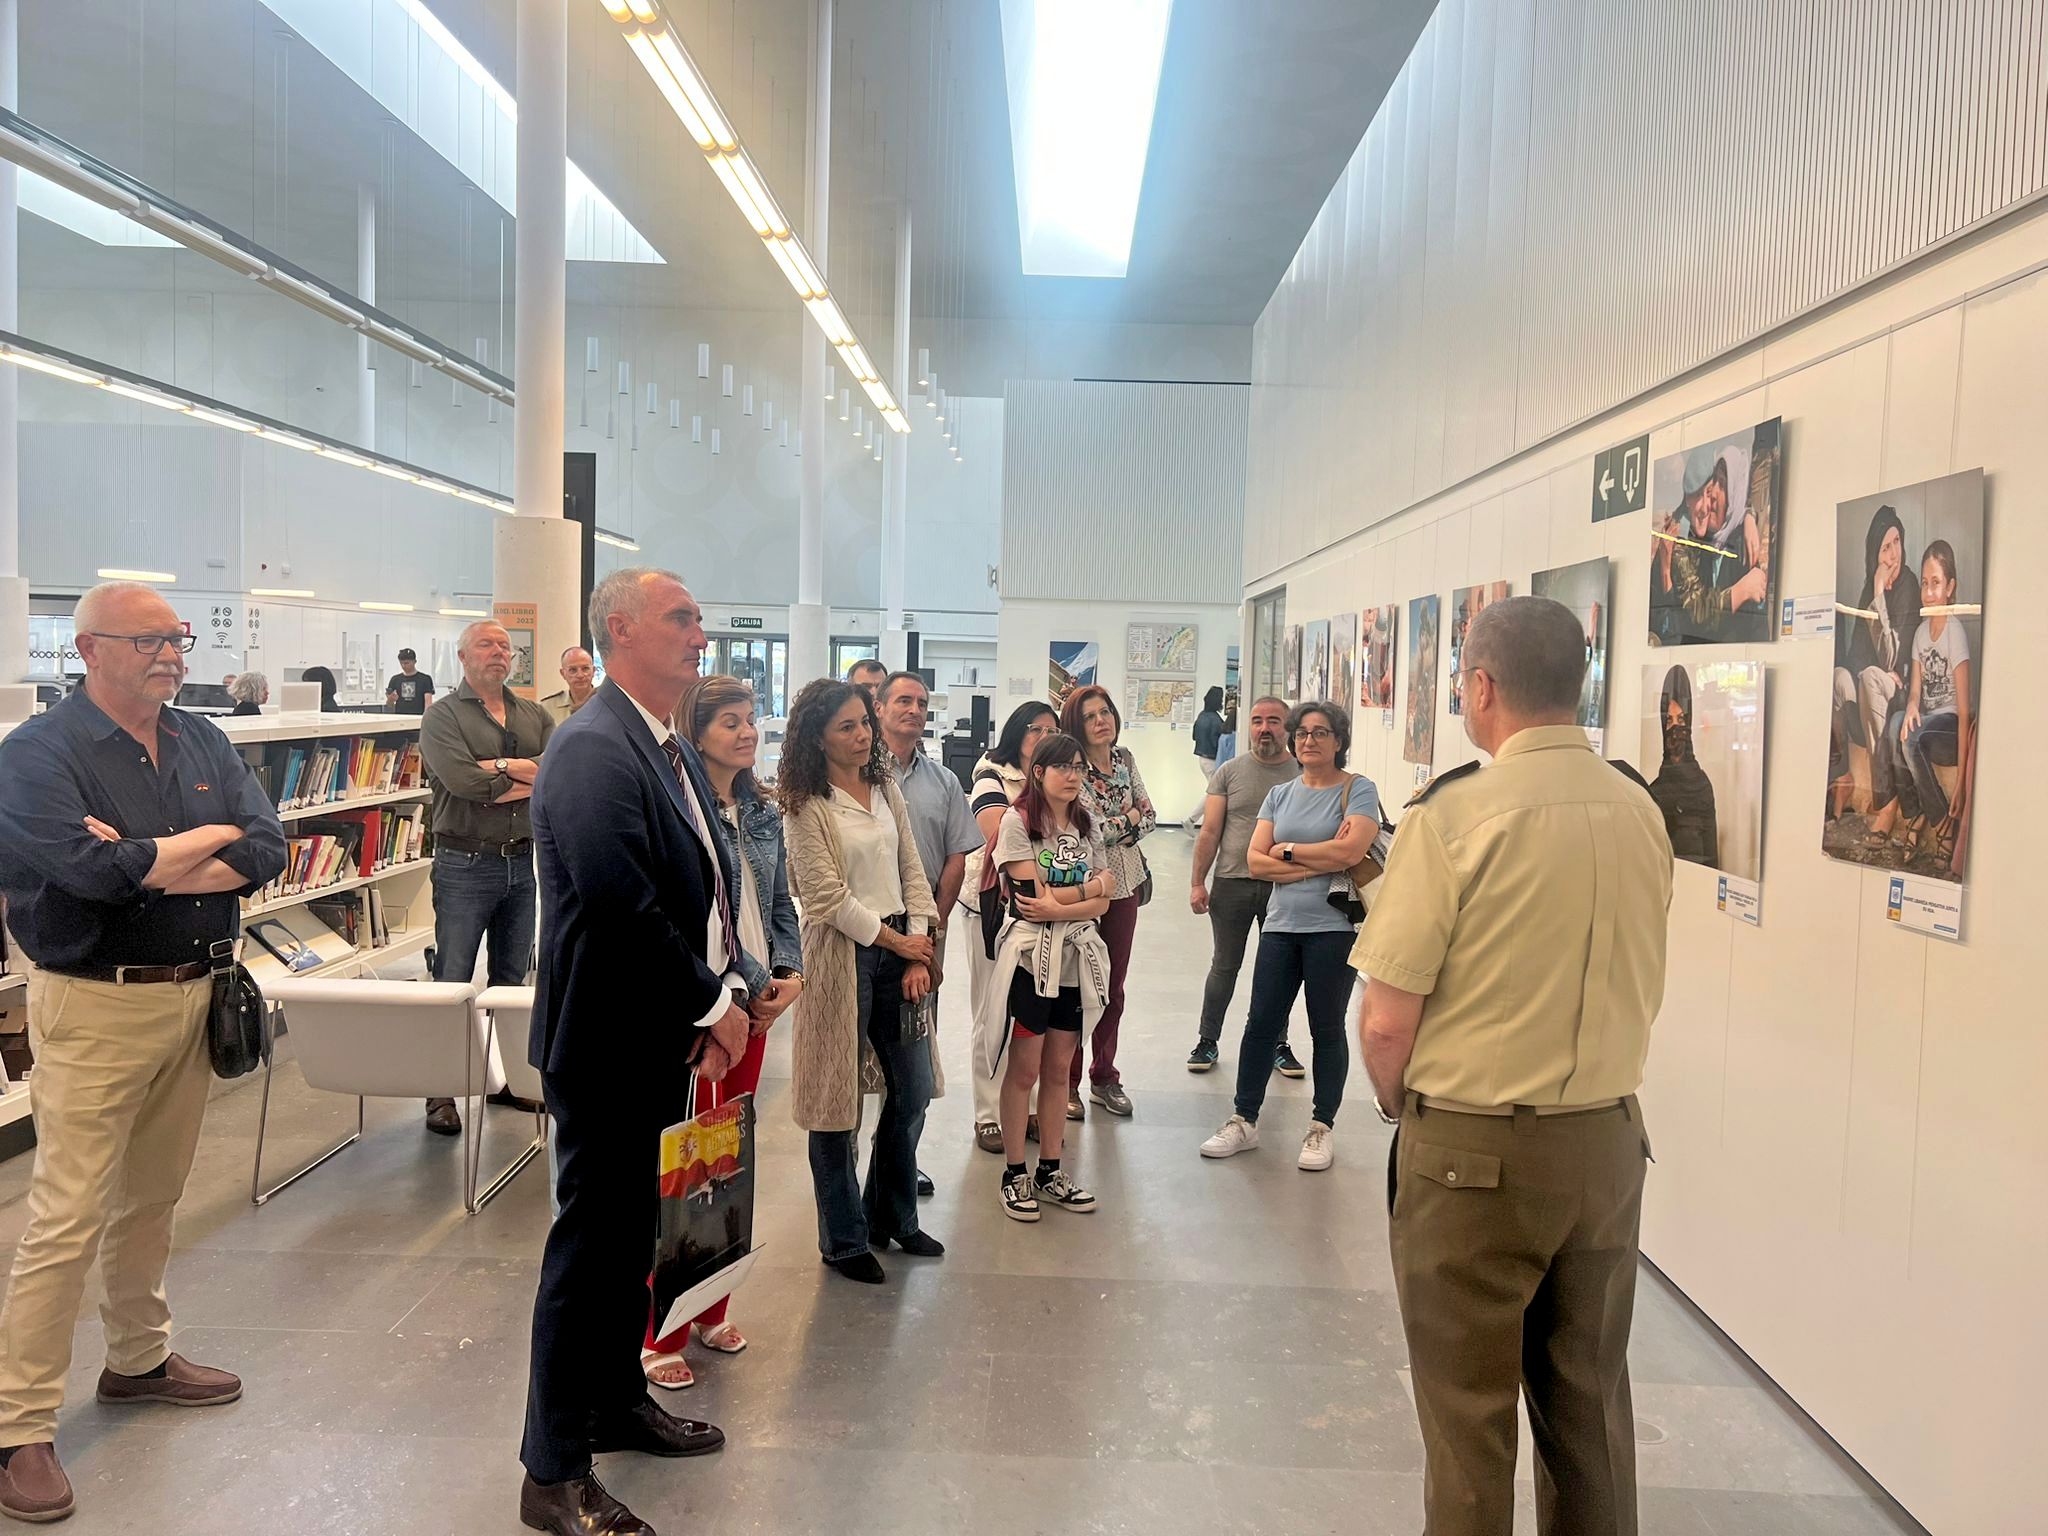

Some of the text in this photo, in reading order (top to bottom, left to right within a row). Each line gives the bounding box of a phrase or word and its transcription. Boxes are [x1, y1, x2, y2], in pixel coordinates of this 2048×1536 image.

[740, 618, 761, 626] SALIDA
[1040, 932, 1051, 980] ATTITUDE
[1088, 952, 1104, 993] ATTITUDE
[705, 1103, 746, 1132] FUERZAS
[705, 1123, 746, 1154] ARMADAS
